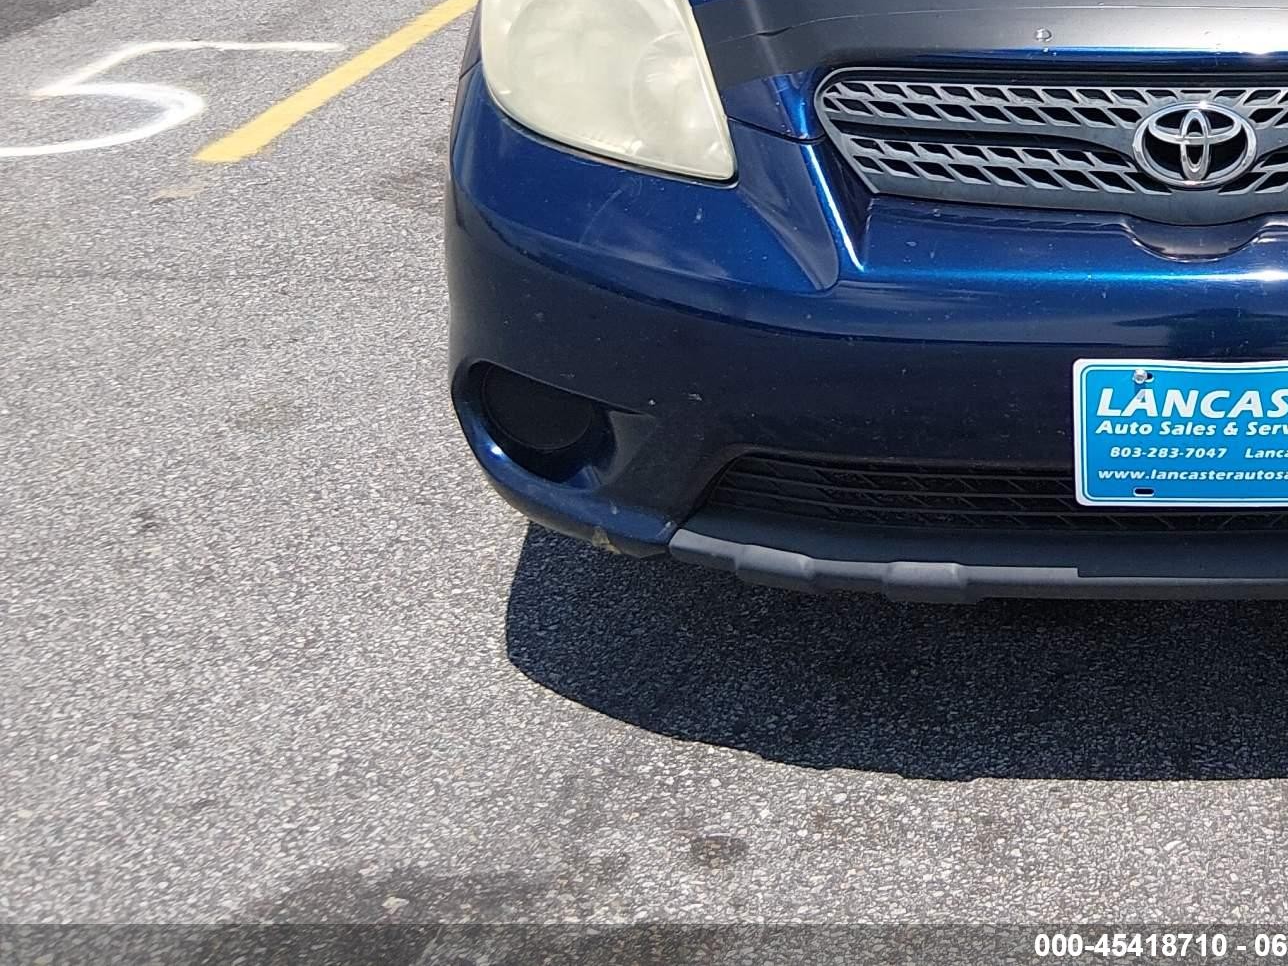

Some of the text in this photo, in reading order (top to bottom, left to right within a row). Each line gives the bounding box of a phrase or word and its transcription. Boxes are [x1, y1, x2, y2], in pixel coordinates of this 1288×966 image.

[1095, 419, 1153, 435] Auto
[1159, 420, 1217, 436] Sales
[1223, 421, 1239, 436] &
[1110, 446, 1228, 458] 803-283-7047
